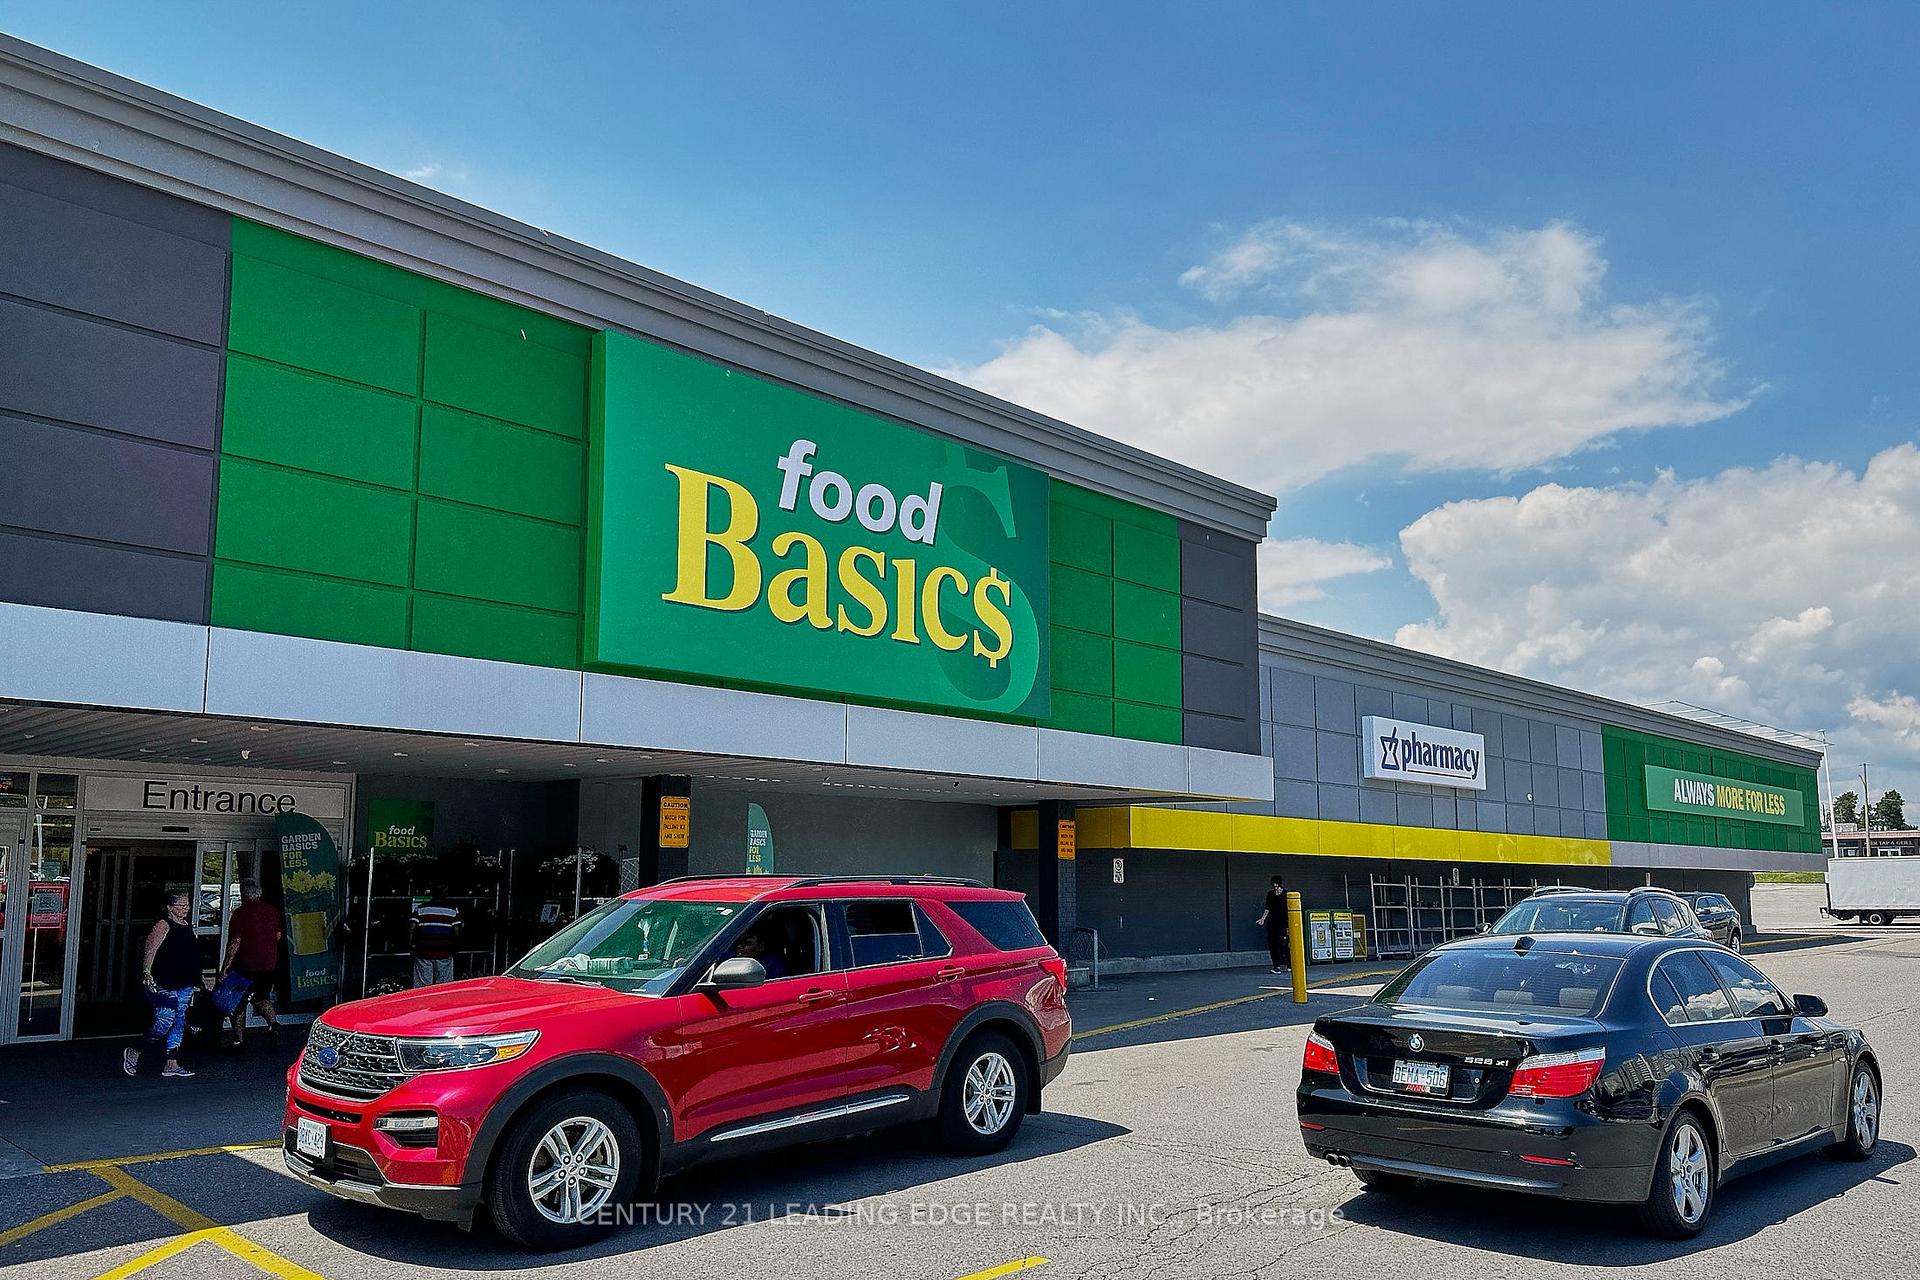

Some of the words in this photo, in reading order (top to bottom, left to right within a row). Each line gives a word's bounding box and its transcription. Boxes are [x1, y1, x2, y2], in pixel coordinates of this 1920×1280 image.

[776, 439, 943, 545] food
[1401, 731, 1480, 780] pharmacy
[143, 781, 296, 814] Entrance
[1674, 778, 1715, 807] ALWAYS
[1716, 784, 1745, 811] MORE
[1745, 789, 1764, 814] FOR
[1763, 791, 1786, 816] LESS
[389, 824, 416, 835] food
[281, 833, 321, 844] GARDEN
[281, 841, 319, 852] BASICS
[282, 851, 303, 860] FOR
[283, 859, 308, 869] LESS
[305, 967, 327, 977] food
